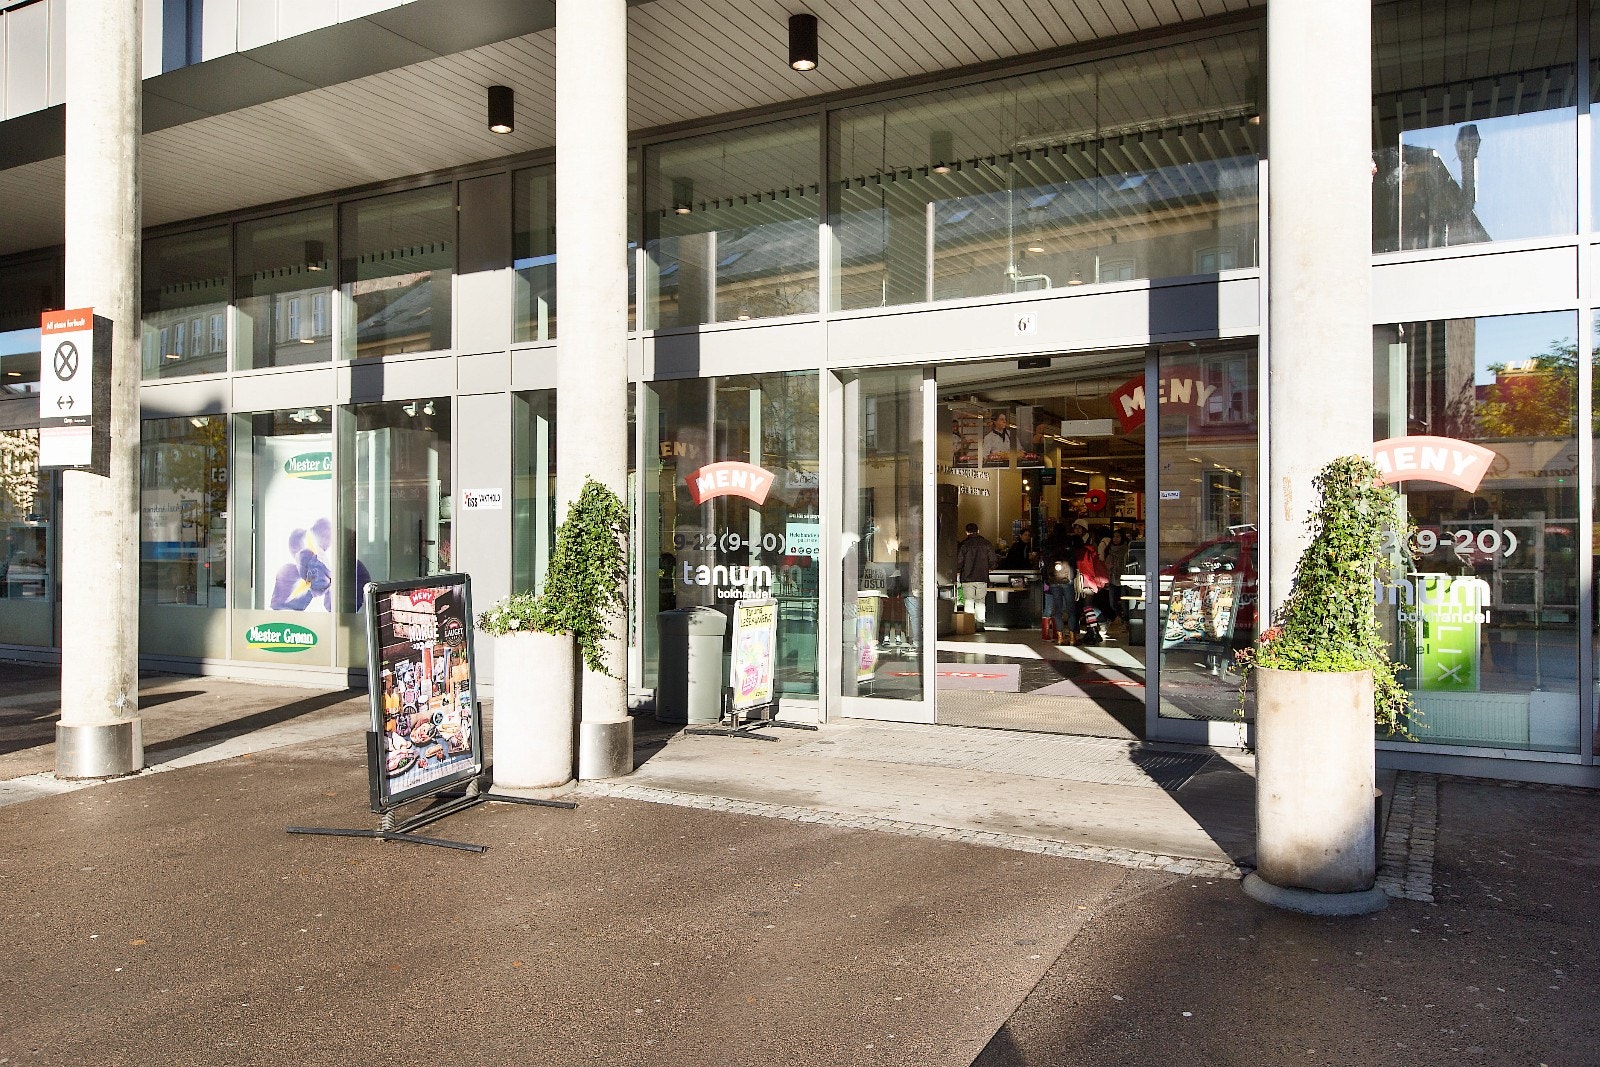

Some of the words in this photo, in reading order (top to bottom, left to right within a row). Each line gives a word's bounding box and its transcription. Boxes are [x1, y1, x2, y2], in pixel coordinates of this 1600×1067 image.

[1120, 379, 1217, 417] MENY
[289, 457, 320, 471] Mester
[696, 470, 764, 494] MENY
[683, 561, 772, 586] tanum
[412, 592, 432, 602] MENY
[717, 588, 772, 599] bokhandel
[1397, 609, 1491, 624] bokhandel
[249, 626, 281, 642] Mester
[283, 628, 314, 645] Grønn
